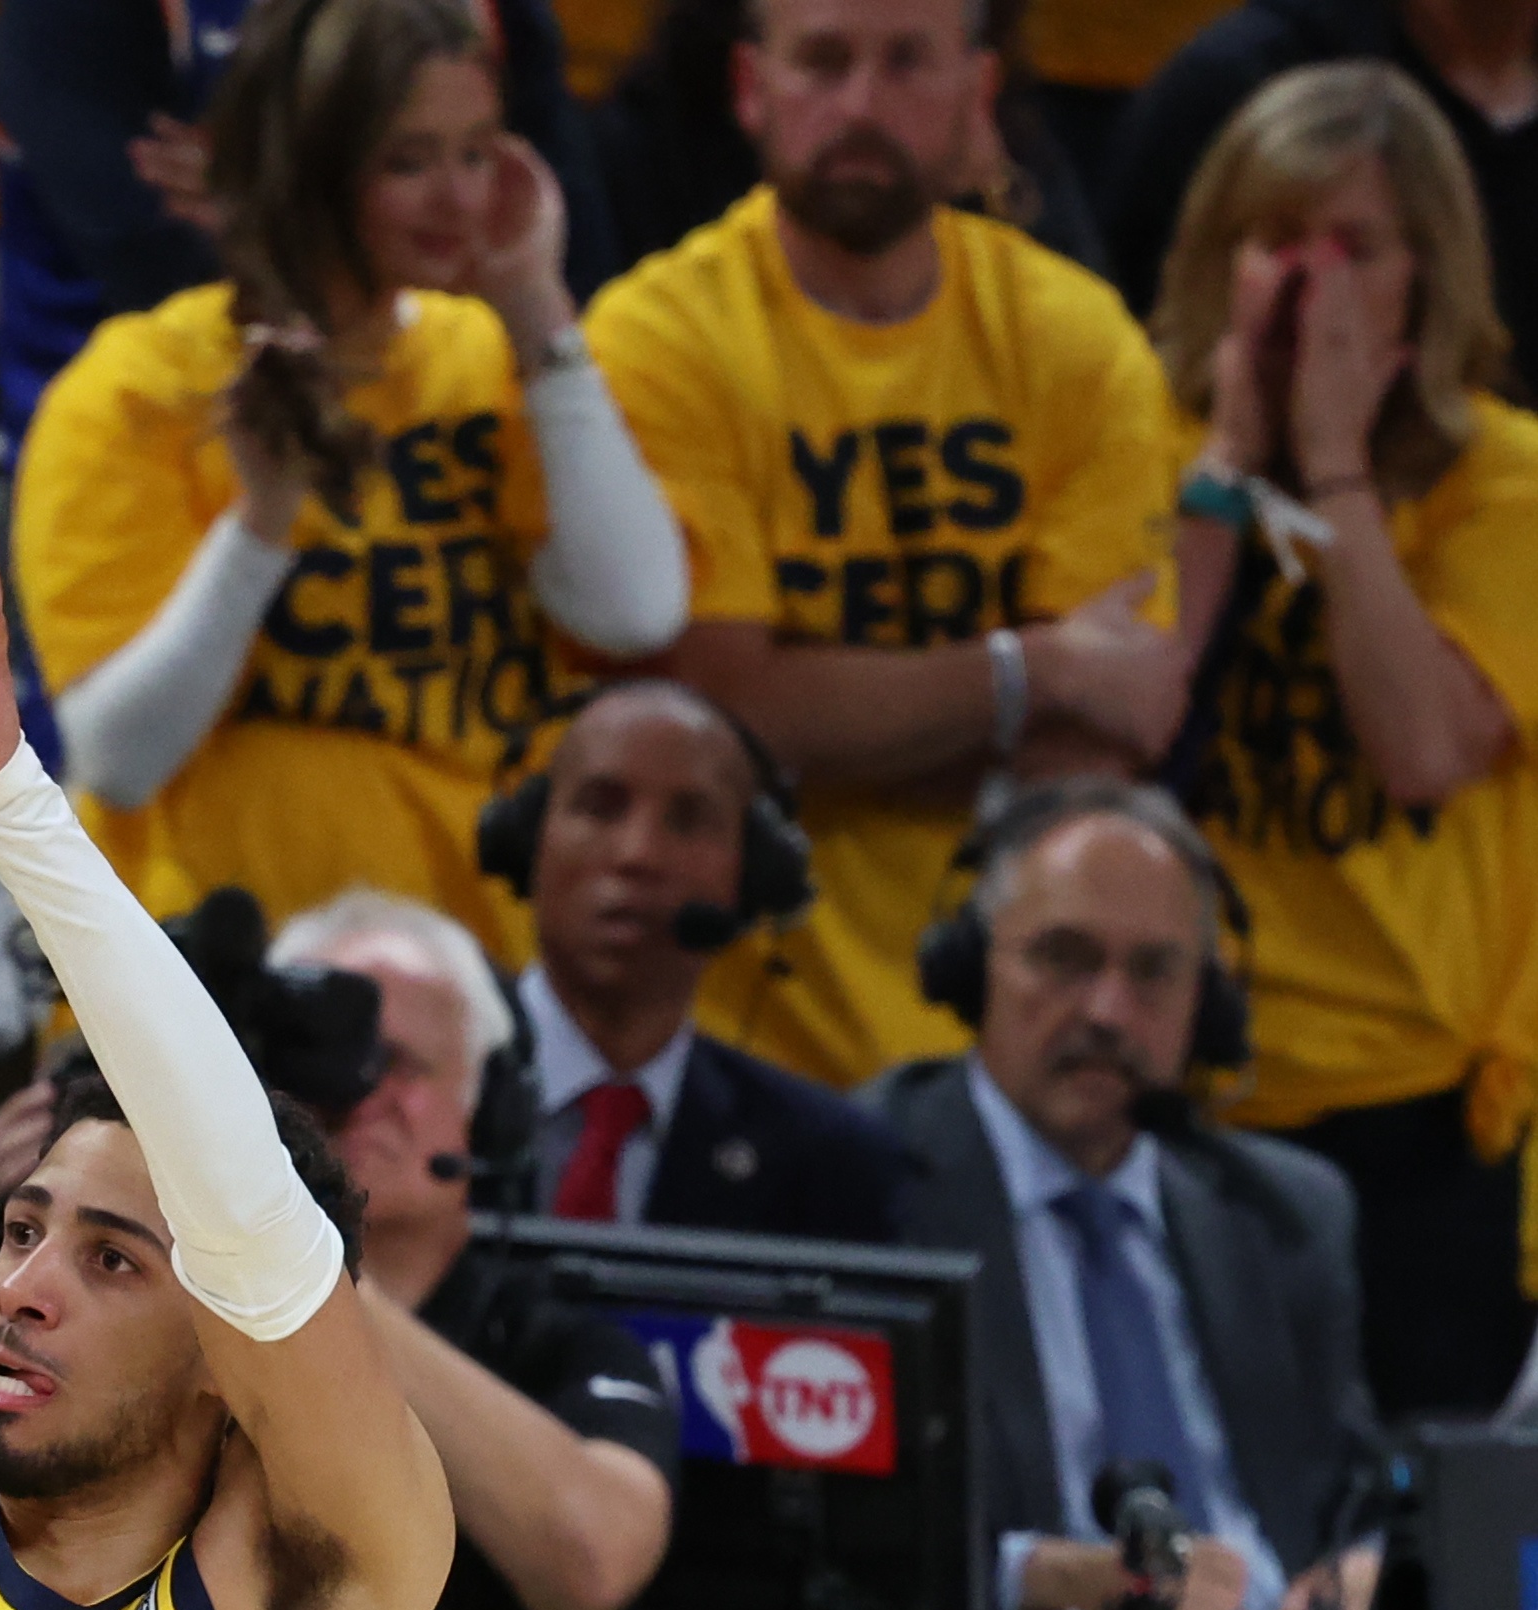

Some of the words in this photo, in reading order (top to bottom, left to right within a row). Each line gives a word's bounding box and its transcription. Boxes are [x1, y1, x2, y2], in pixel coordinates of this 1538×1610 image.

[789, 419, 1026, 537] YES
[263, 535, 513, 658] CER
[760, 1375, 872, 1421] TNT
